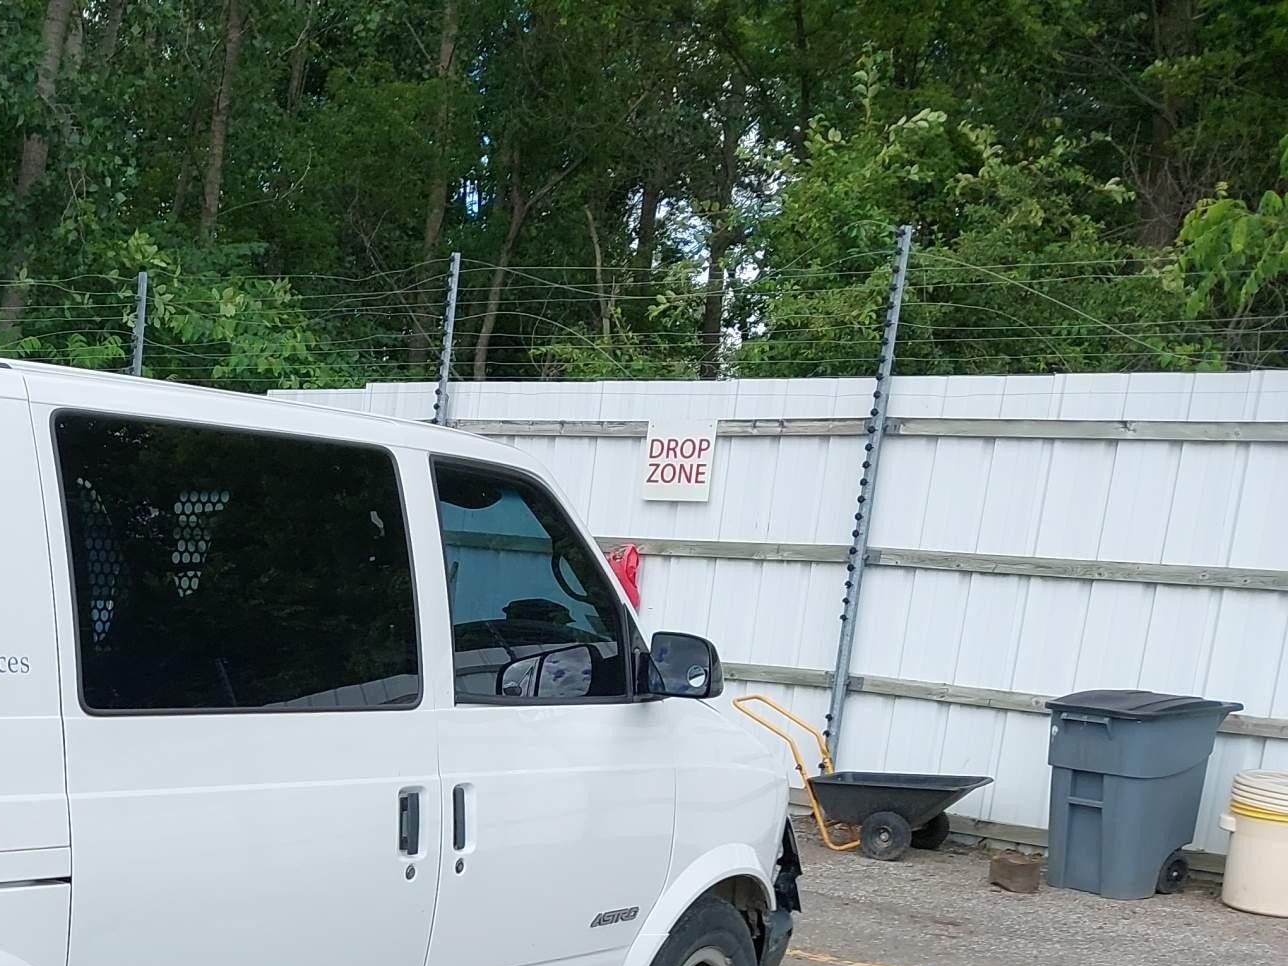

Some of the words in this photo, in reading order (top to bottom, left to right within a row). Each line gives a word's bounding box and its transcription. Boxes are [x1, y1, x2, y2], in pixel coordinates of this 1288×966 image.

[649, 438, 711, 459] DROP
[646, 463, 707, 484] ZONE
[590, 906, 639, 928] ASTRO
